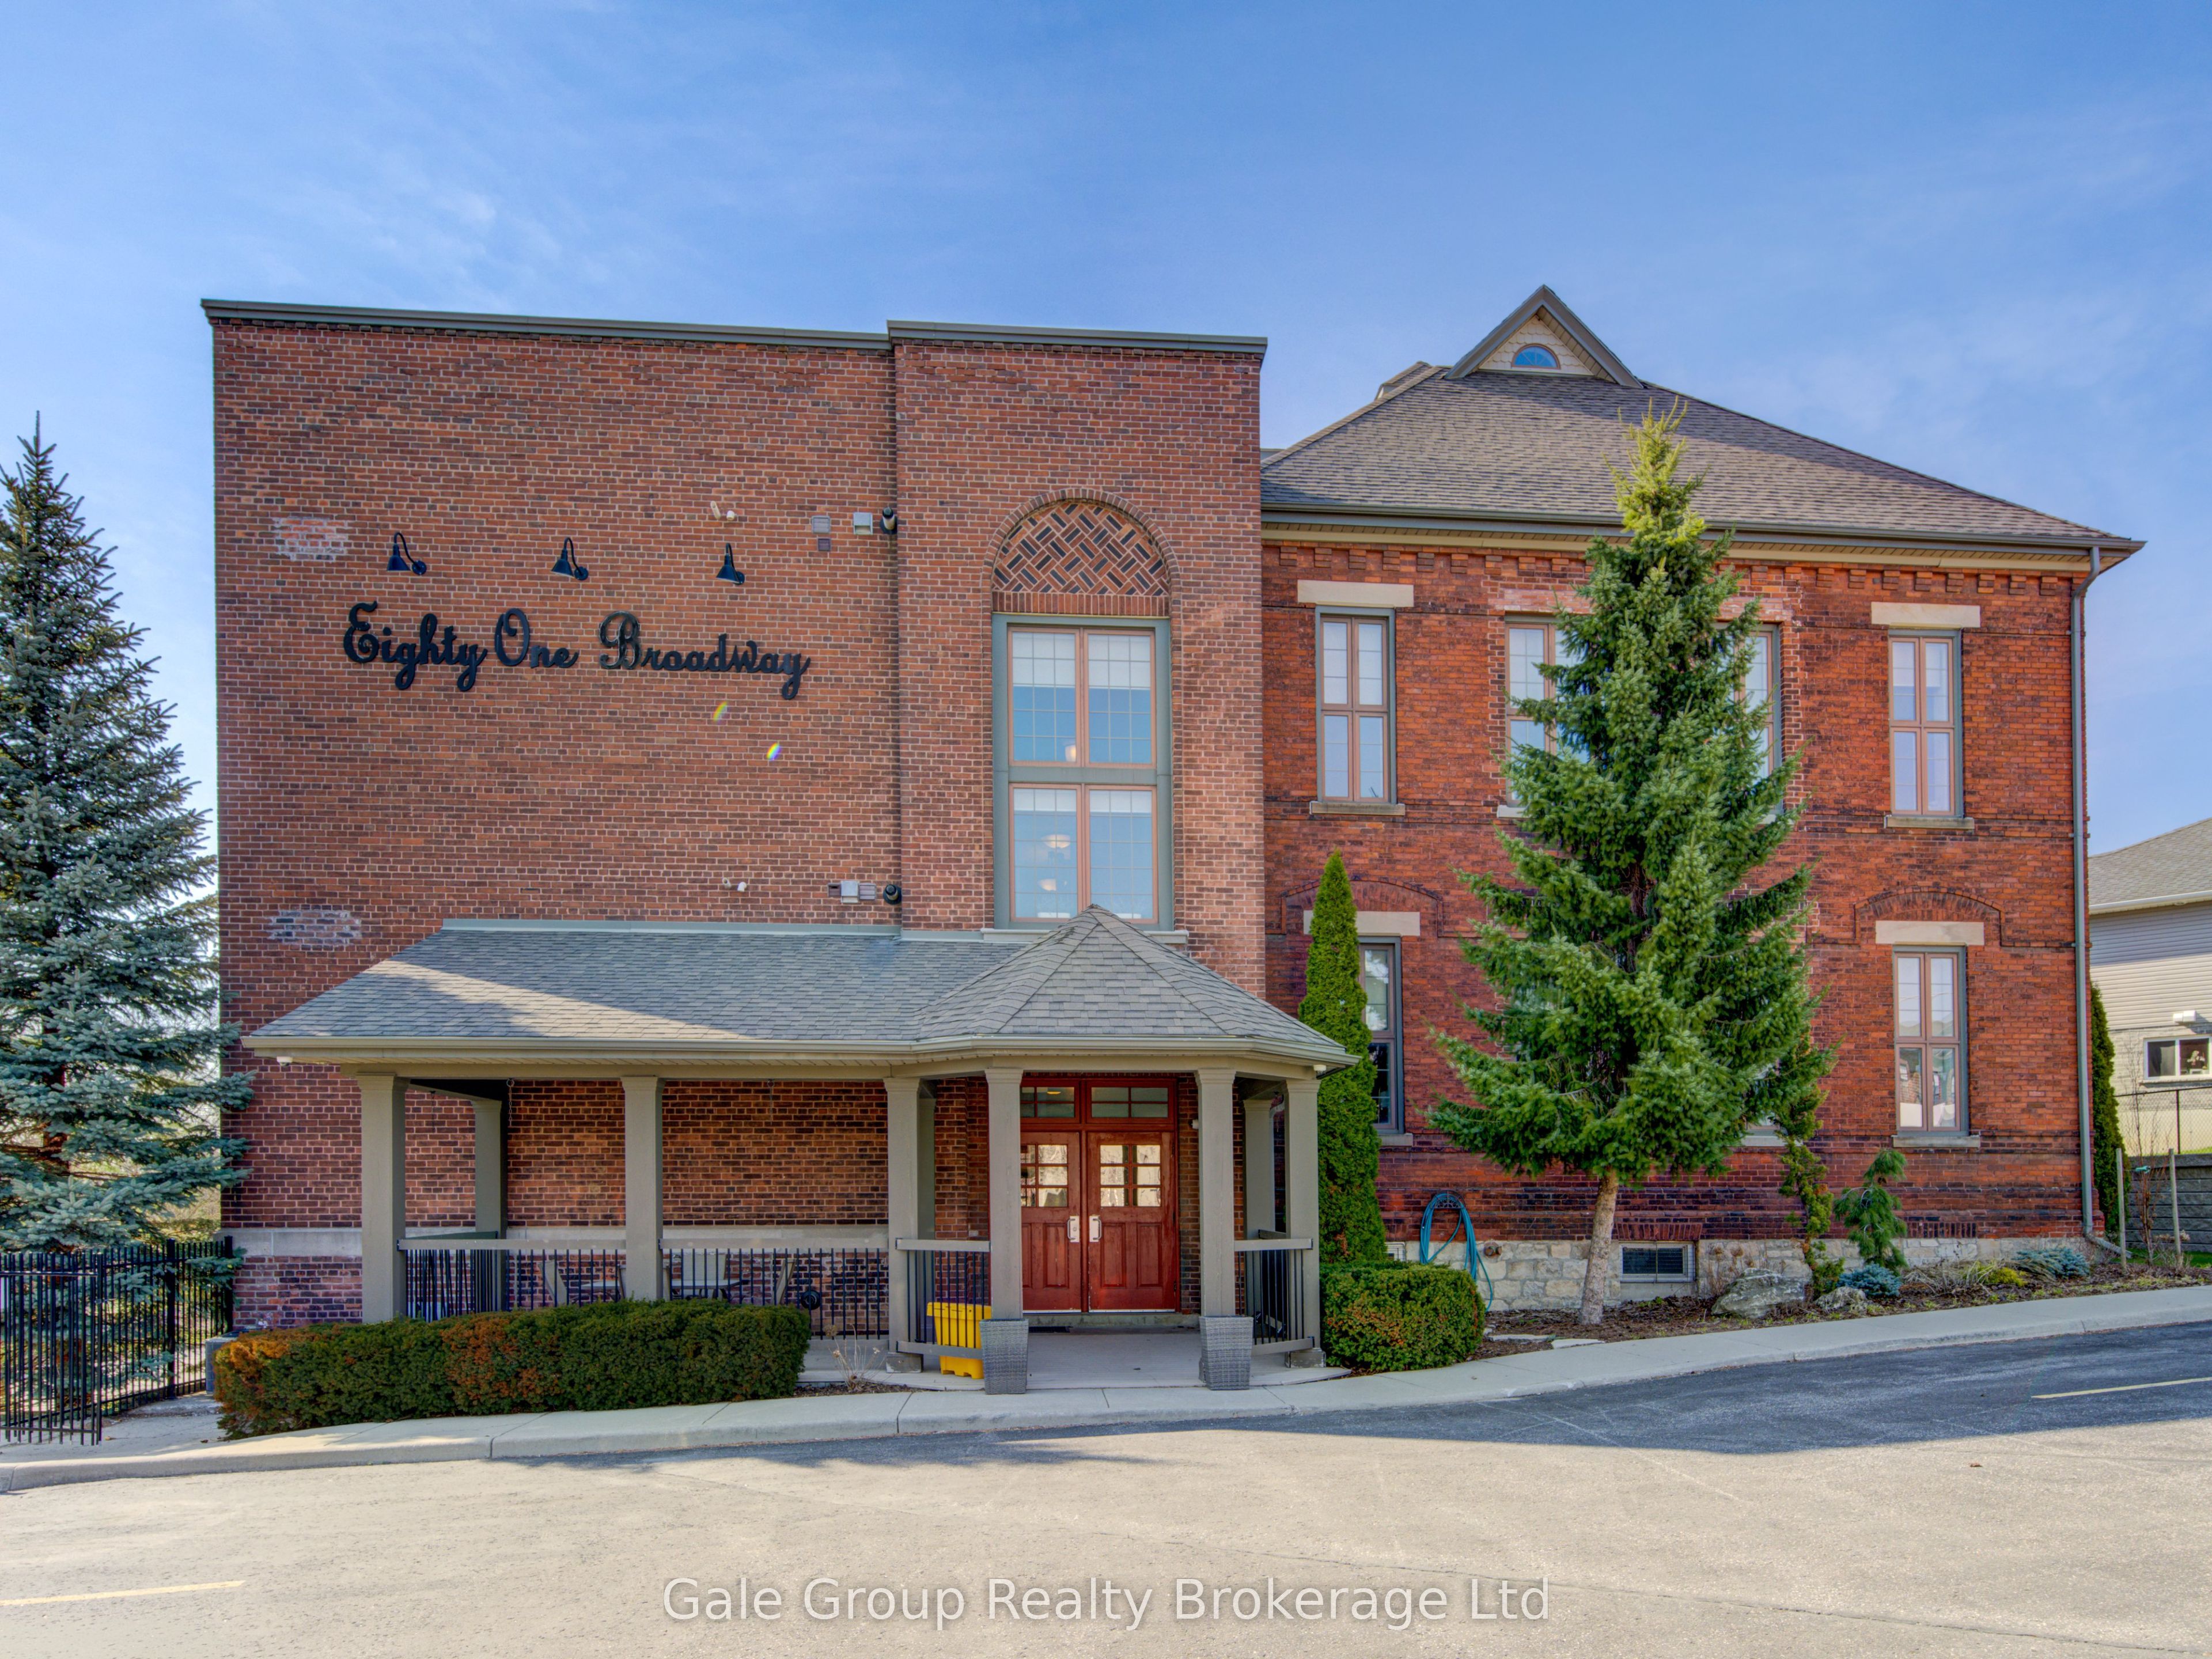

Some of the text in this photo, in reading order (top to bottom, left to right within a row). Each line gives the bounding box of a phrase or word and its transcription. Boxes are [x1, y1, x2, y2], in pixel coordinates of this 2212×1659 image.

[343, 600, 811, 700] Eighty One Broadway
